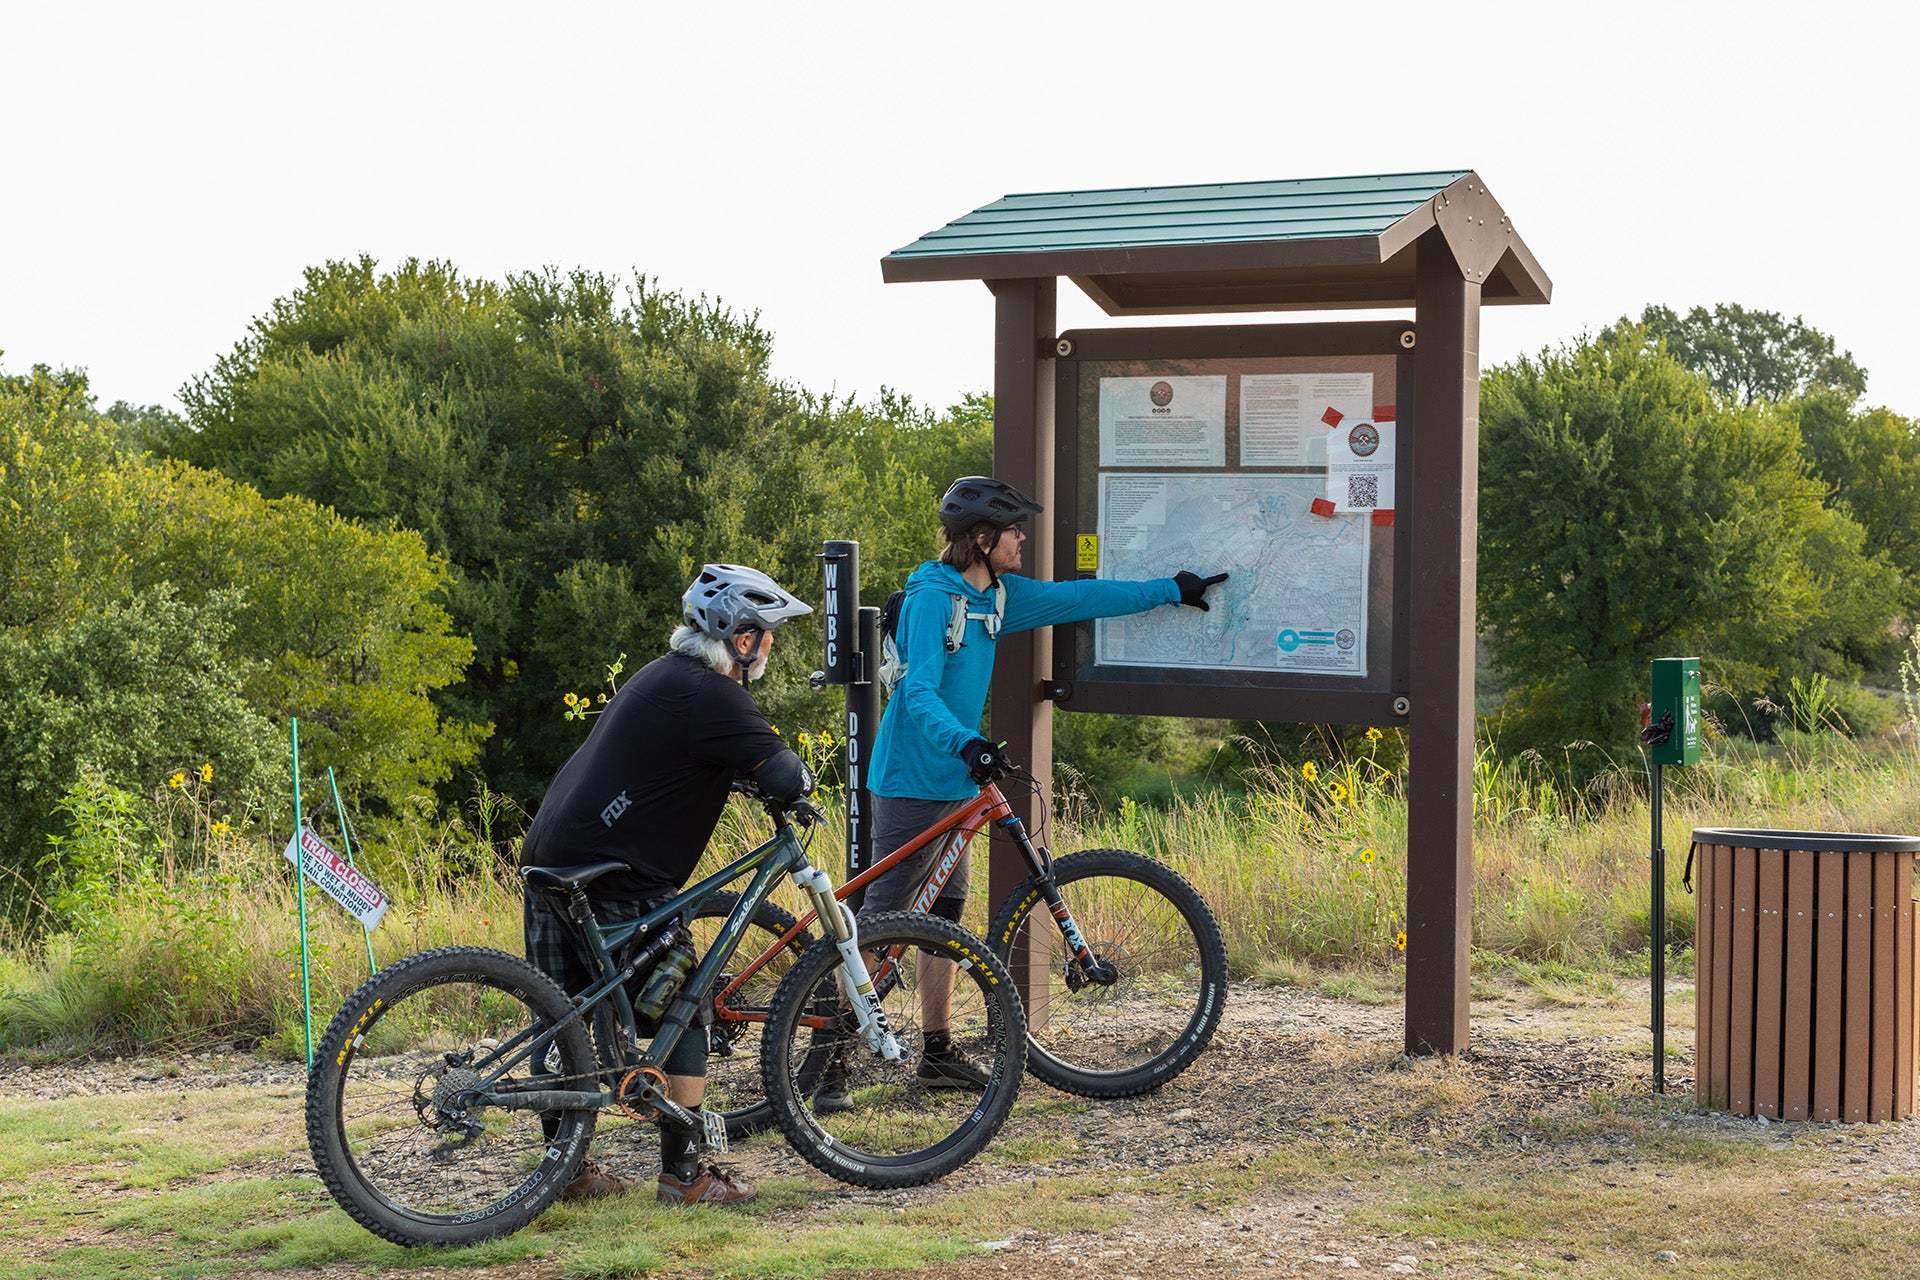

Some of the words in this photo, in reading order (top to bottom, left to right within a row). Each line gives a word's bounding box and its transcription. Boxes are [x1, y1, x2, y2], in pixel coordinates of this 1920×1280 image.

[825, 563, 838, 668] WMBC
[600, 790, 633, 828] FOX
[849, 711, 860, 869] DONATE
[303, 833, 334, 868] TRAIL
[335, 861, 382, 907] CLOSED
[935, 832, 967, 885] CRUZ
[314, 860, 323, 872] TO
[324, 869, 341, 886] WET
[346, 889, 373, 913] MUDDY
[320, 876, 364, 917] CONDITIONS
[1002, 888, 1039, 944] MAXXIS
[946, 939, 999, 985] MAXXIS
[335, 998, 383, 1067] MAXXIS
